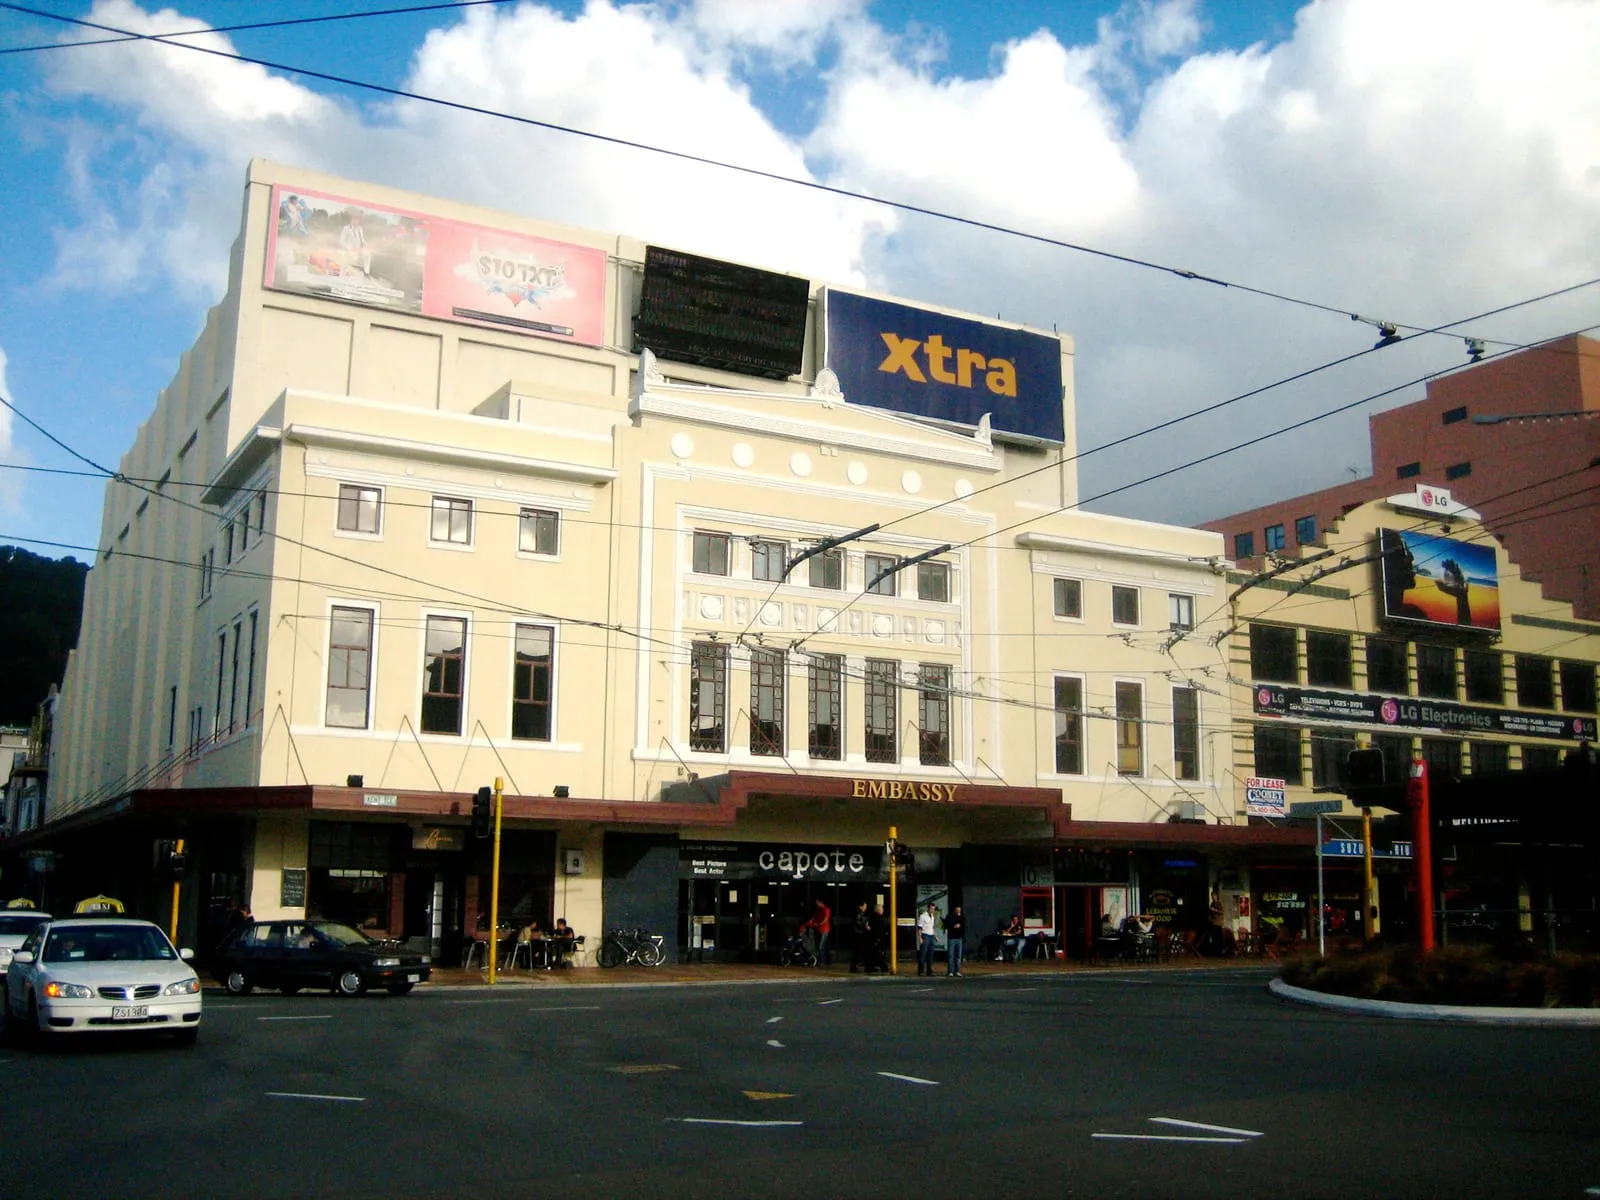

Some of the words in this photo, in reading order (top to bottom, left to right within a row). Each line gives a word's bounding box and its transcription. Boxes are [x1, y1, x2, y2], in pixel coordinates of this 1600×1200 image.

[877, 332, 1017, 397] xtra
[1434, 495, 1447, 507] LG
[1272, 692, 1285, 703] LG
[1400, 704, 1418, 720] LG
[1421, 706, 1492, 727] Electronics
[852, 779, 958, 802] EMBASSY
[1247, 778, 1260, 787] FOR
[1263, 779, 1284, 789] LEASE
[759, 850, 864, 879] capote
